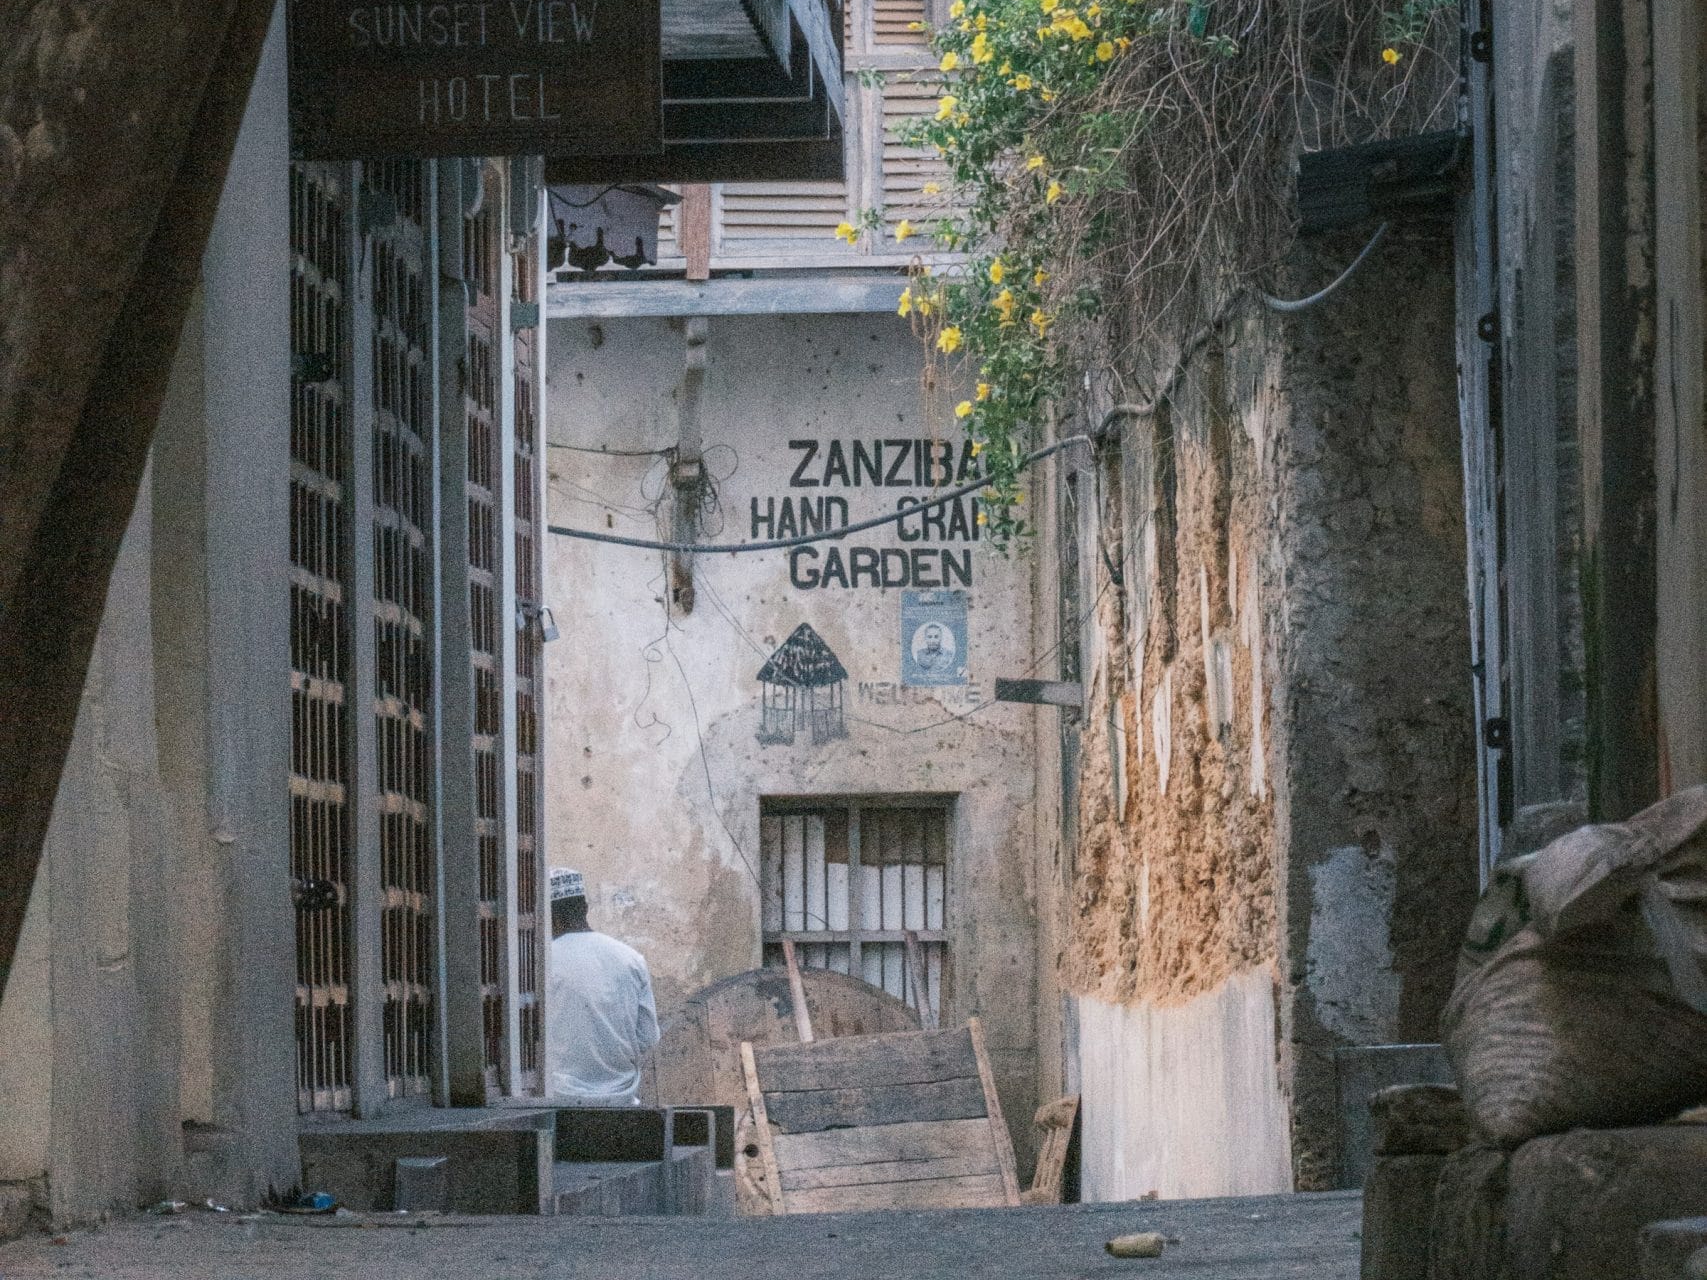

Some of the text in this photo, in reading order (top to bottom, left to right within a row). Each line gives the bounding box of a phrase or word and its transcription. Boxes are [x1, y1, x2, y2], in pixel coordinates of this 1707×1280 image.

[348, 0, 599, 47] SUNSET VIEW
[418, 73, 561, 123] HOTEL
[788, 439, 995, 487] ZANZIBA
[750, 495, 849, 540] HAND
[789, 545, 973, 590] GARDEN
